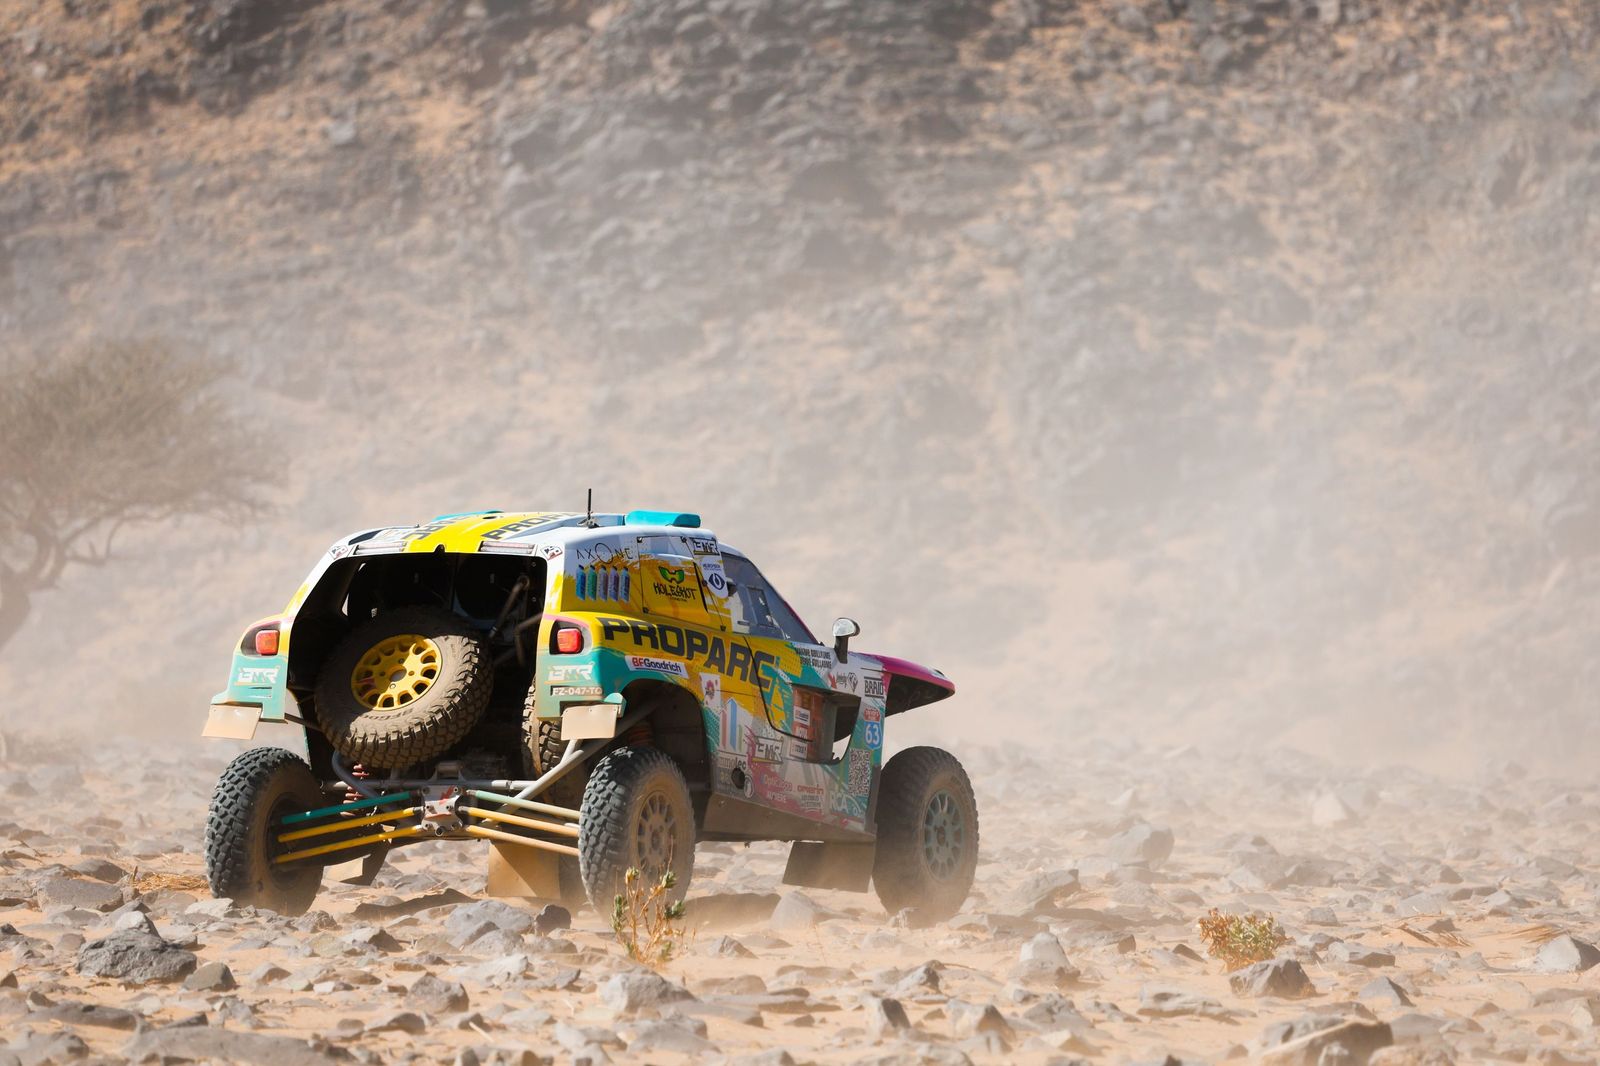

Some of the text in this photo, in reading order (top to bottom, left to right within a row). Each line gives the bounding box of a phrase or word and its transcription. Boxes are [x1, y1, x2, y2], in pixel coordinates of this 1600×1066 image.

[653, 581, 697, 600] HOLESHOT
[596, 617, 775, 689] PROPARC
[631, 657, 682, 673] BFGoodrich
[864, 680, 884, 695] BRAID
[865, 723, 880, 745] 63
